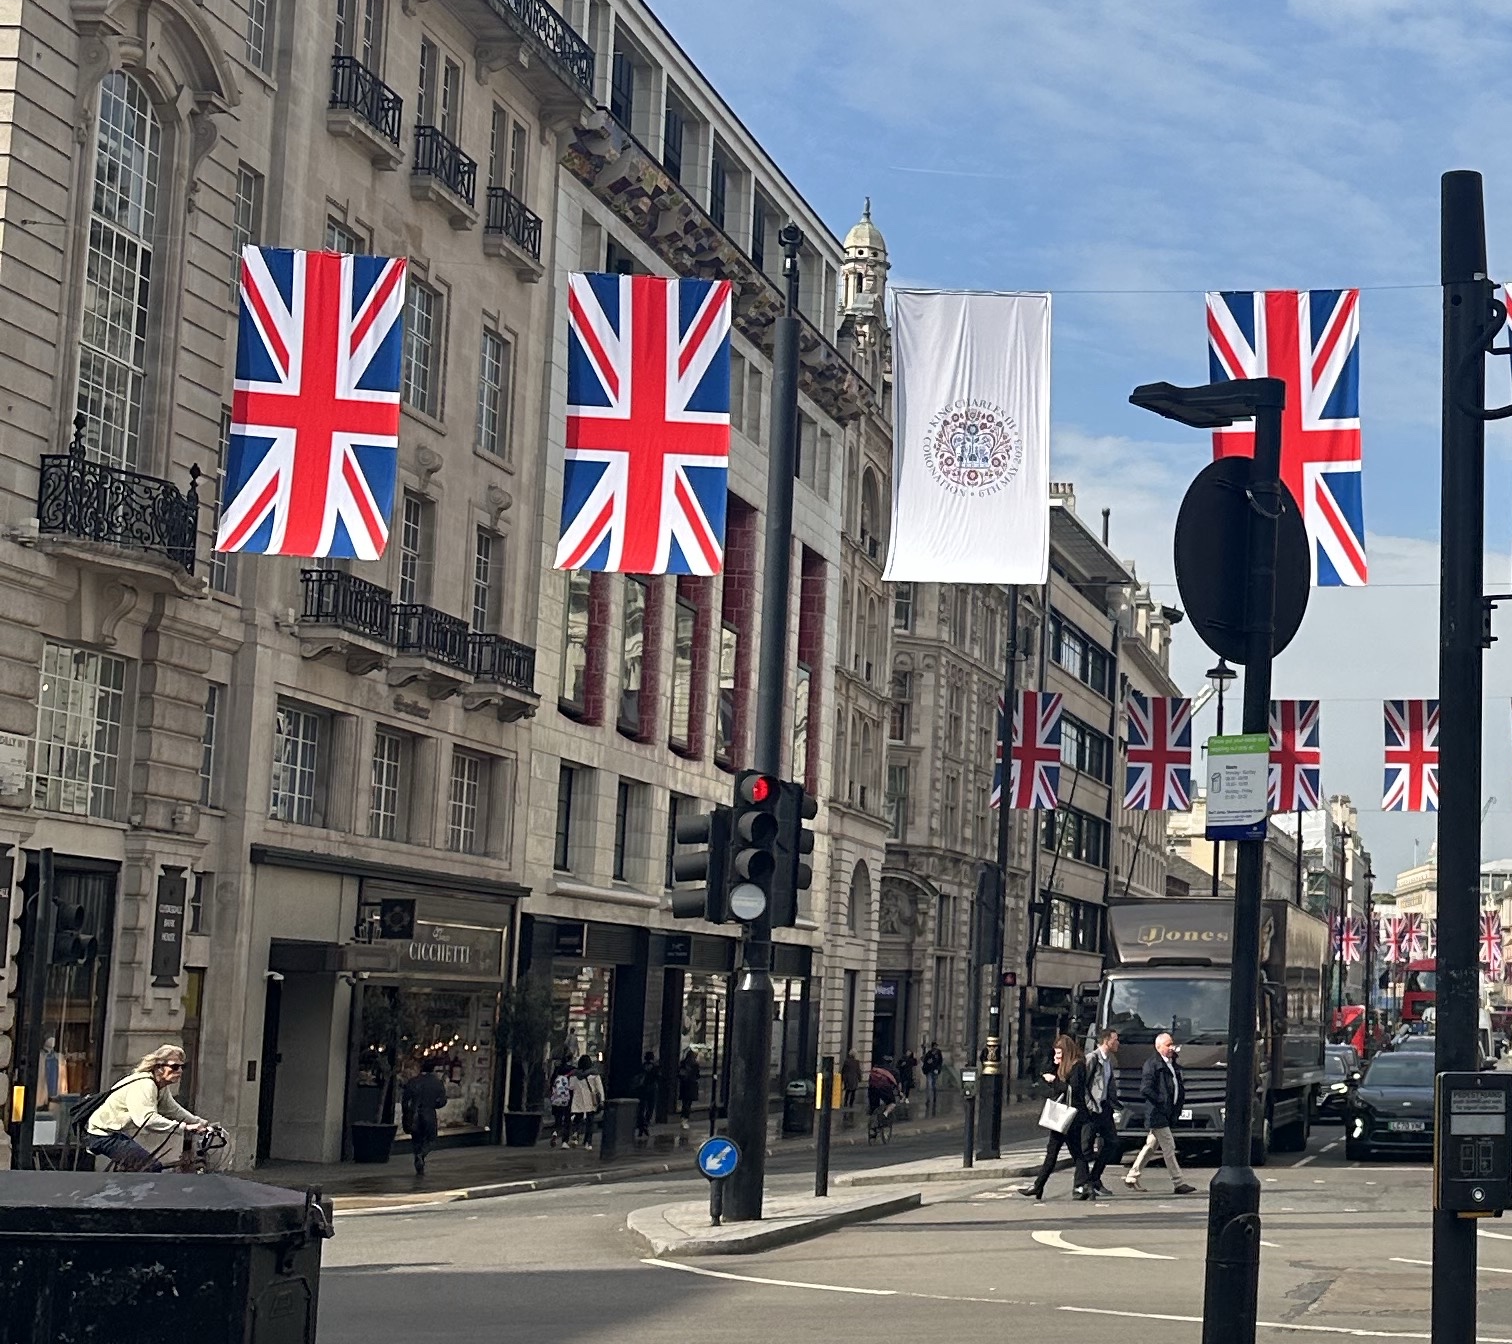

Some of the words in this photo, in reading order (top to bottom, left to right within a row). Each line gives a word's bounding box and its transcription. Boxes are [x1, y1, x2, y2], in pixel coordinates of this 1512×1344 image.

[929, 403, 954, 429] KING
[954, 398, 1006, 417] CHARLES
[1004, 416, 1017, 430] III
[922, 436, 966, 498] CORONATION
[978, 484, 1001, 498] 6TH
[1001, 467, 1019, 488] MAY
[1012, 439, 1023, 465] 2023
[1142, 927, 1229, 942] Jones
[409, 942, 470, 964] CICCHETTI
